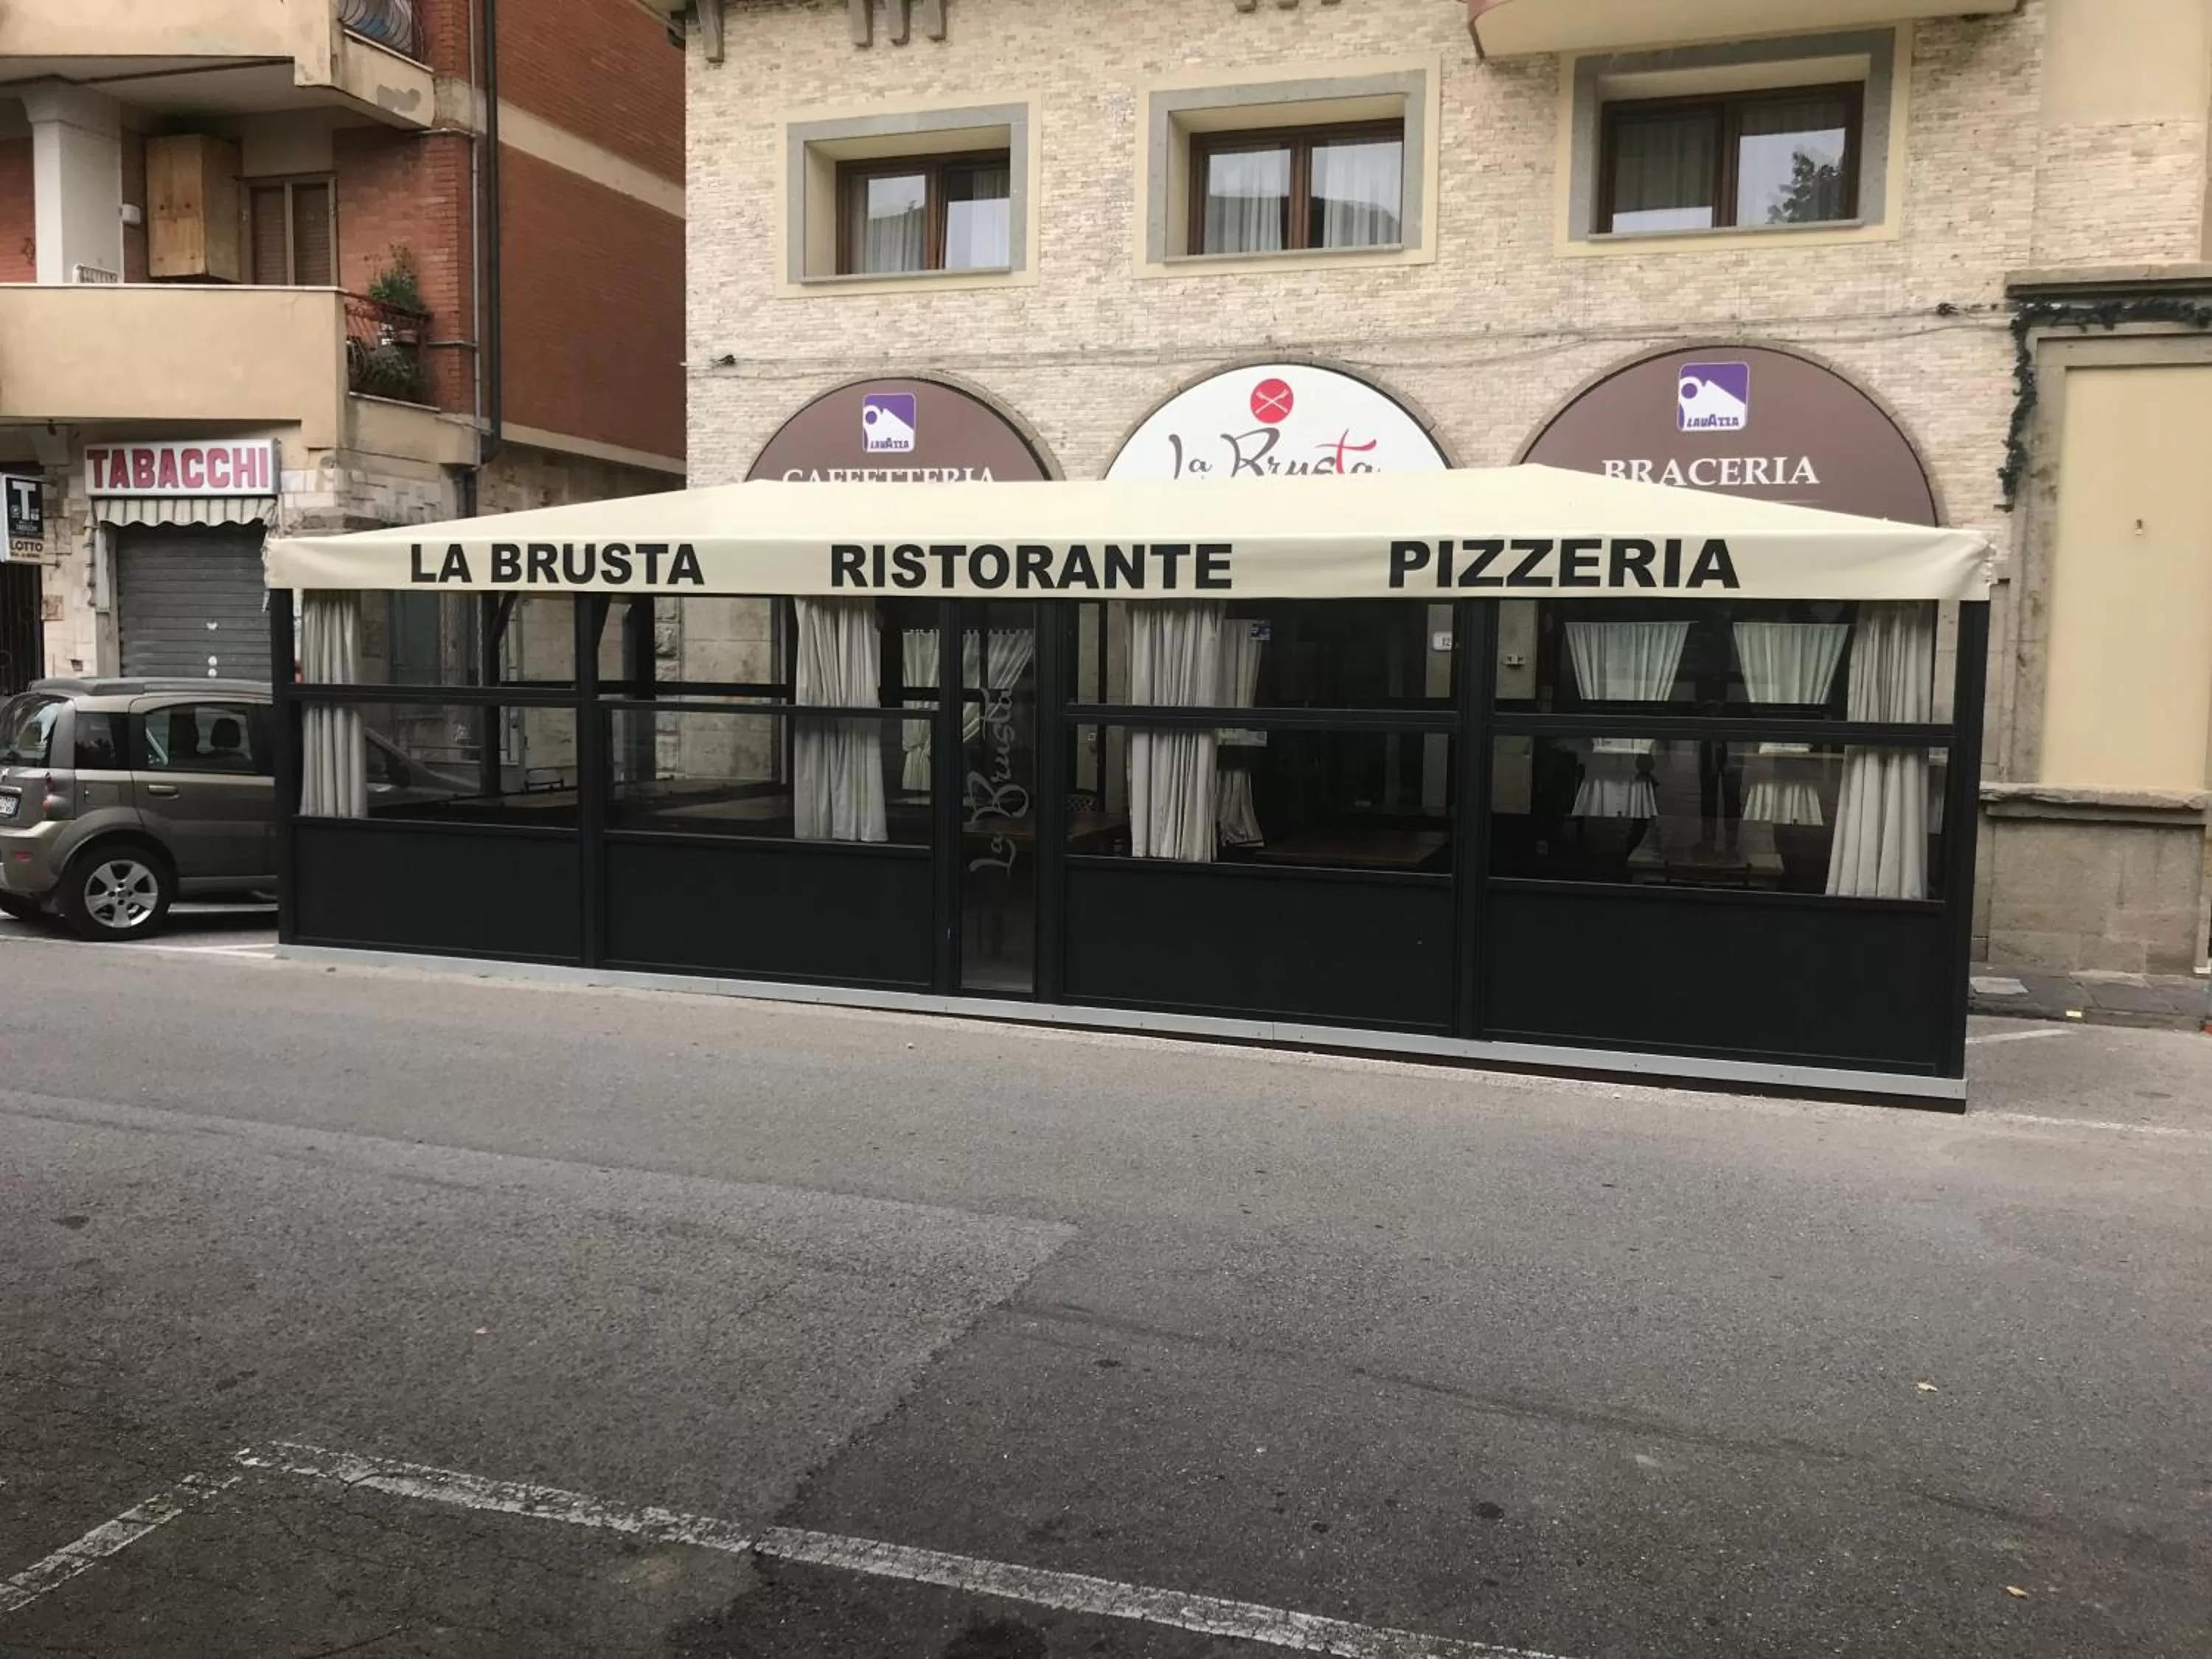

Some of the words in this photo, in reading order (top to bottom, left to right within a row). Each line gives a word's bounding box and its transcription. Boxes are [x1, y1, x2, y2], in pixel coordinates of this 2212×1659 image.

[1686, 411, 1740, 428] LAVAZZA
[86, 447, 269, 489] TABACCHI
[1601, 456, 1820, 486] BRACERIA
[11, 539, 44, 552] LOTTO
[411, 543, 472, 583] LA
[491, 543, 705, 585] BRUSTA
[831, 543, 1232, 589] RISTORANTE
[1389, 538, 1740, 589] PIZZERIA
[961, 686, 1030, 832] Brusta
[968, 832, 1018, 879] La
